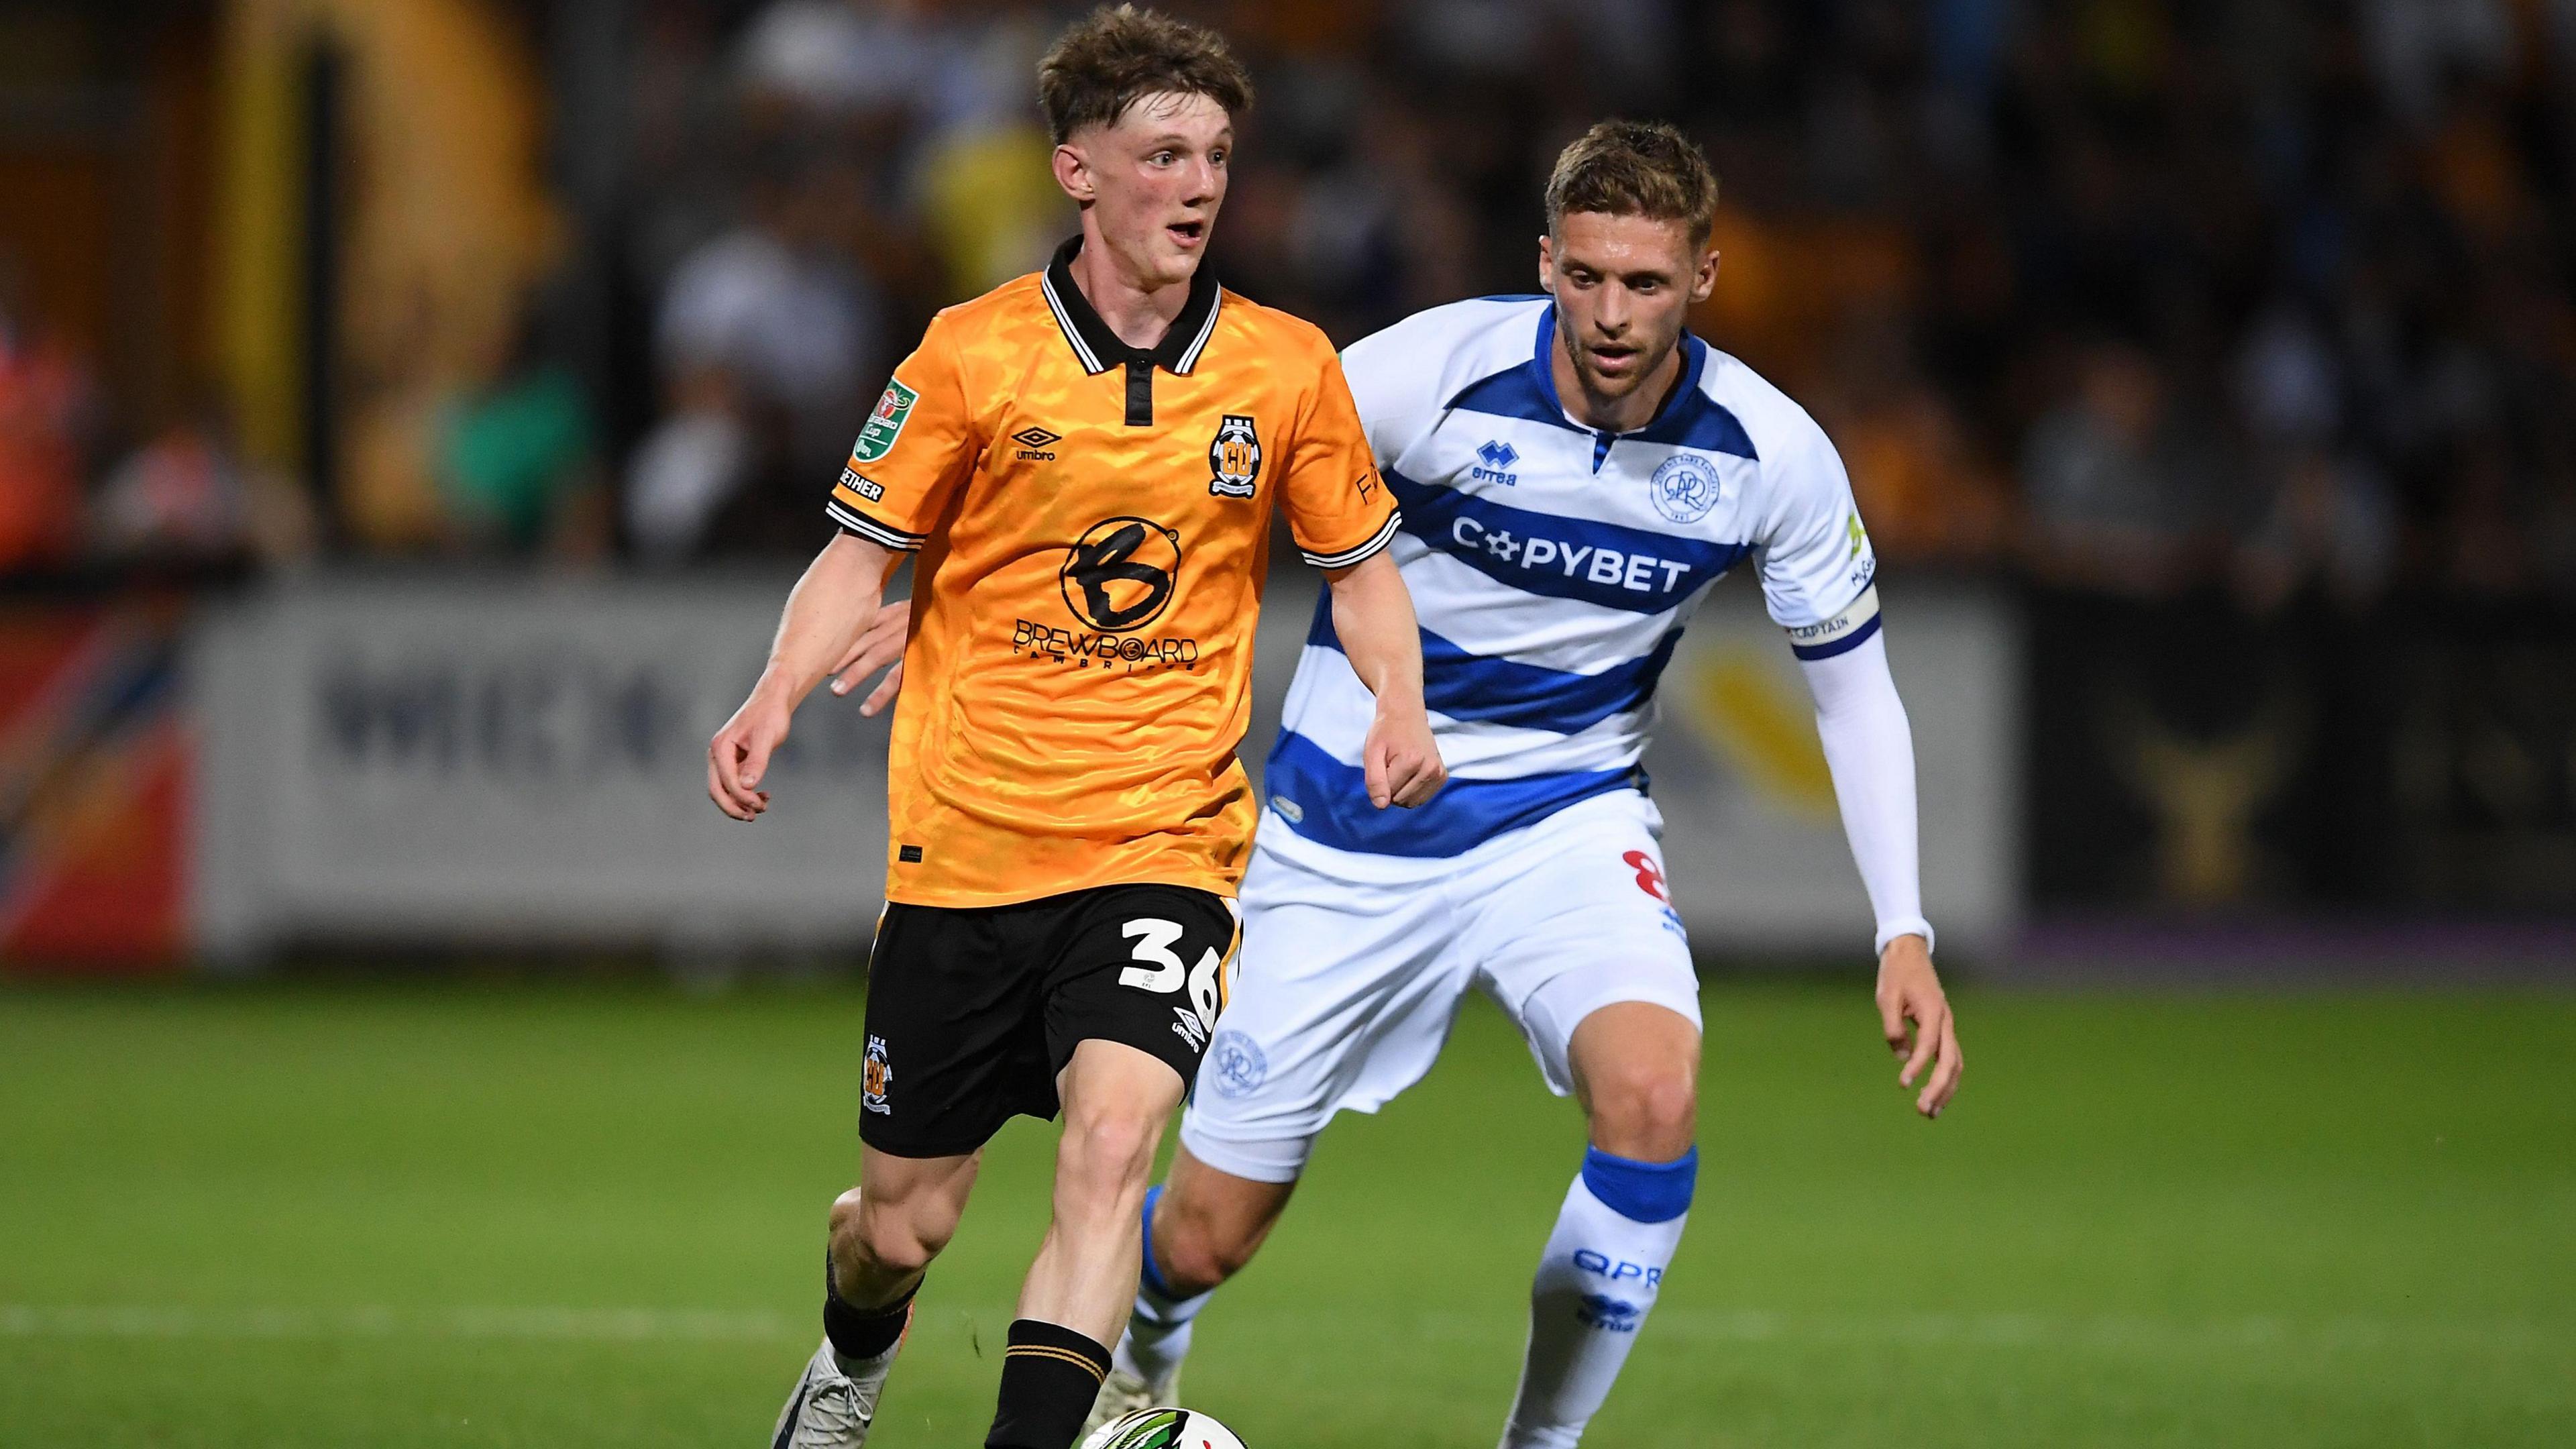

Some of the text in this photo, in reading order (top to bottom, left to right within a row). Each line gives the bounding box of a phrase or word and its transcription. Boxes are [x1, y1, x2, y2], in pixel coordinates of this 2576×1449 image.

[1016, 449, 1055, 462] umbro
[1118, 918, 1220, 1034] 36
[1171, 1022, 1199, 1053] umbro
[1573, 1249, 1662, 1288] QPR
